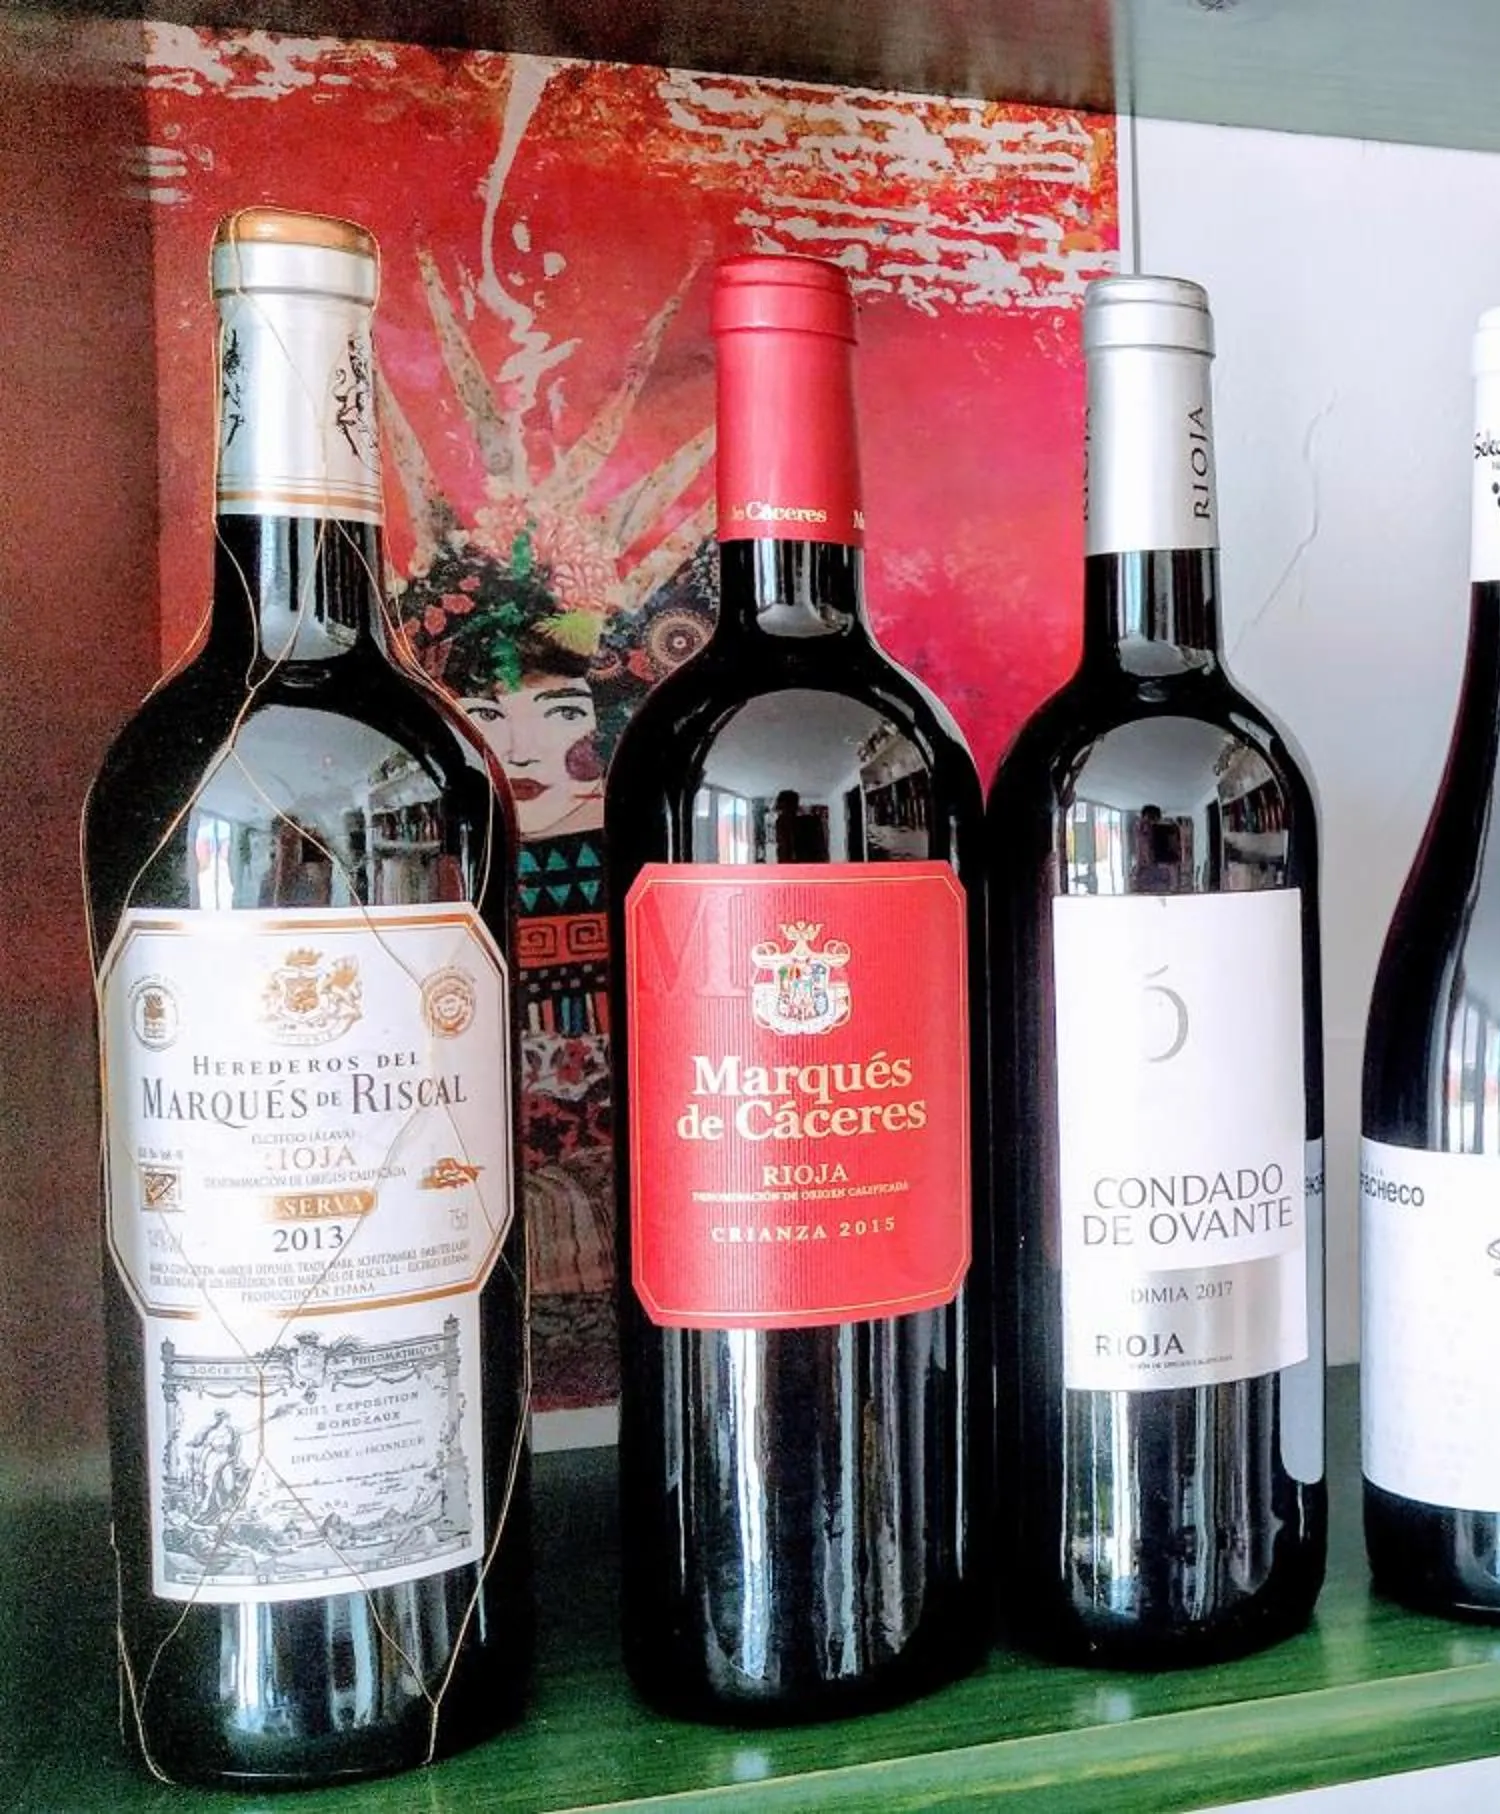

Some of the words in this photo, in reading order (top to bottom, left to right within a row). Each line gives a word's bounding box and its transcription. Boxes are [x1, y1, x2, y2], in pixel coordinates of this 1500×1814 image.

[1188, 407, 1210, 520] RIOJA
[193, 1055, 360, 1077] HEREDEROS
[377, 1051, 419, 1070] DEL
[691, 1051, 913, 1105] Marqués
[142, 1076, 308, 1129] MARQUÉS
[317, 1090, 342, 1108] DE
[353, 1072, 468, 1114] RISCAL
[677, 1105, 725, 1141] de
[735, 1098, 927, 1141] Cáceres
[762, 1163, 849, 1187] RIOJA
[1093, 1163, 1283, 1210] CONDADO
[711, 1224, 828, 1244] CRIANZA
[840, 1216, 896, 1238] 2015
[1083, 1214, 1134, 1246] DE
[1149, 1196, 1294, 1245] OVANTE
[272, 1225, 344, 1253] 2013
[1196, 1280, 1233, 1300] 2017
[1095, 1332, 1185, 1357] RIOJA
